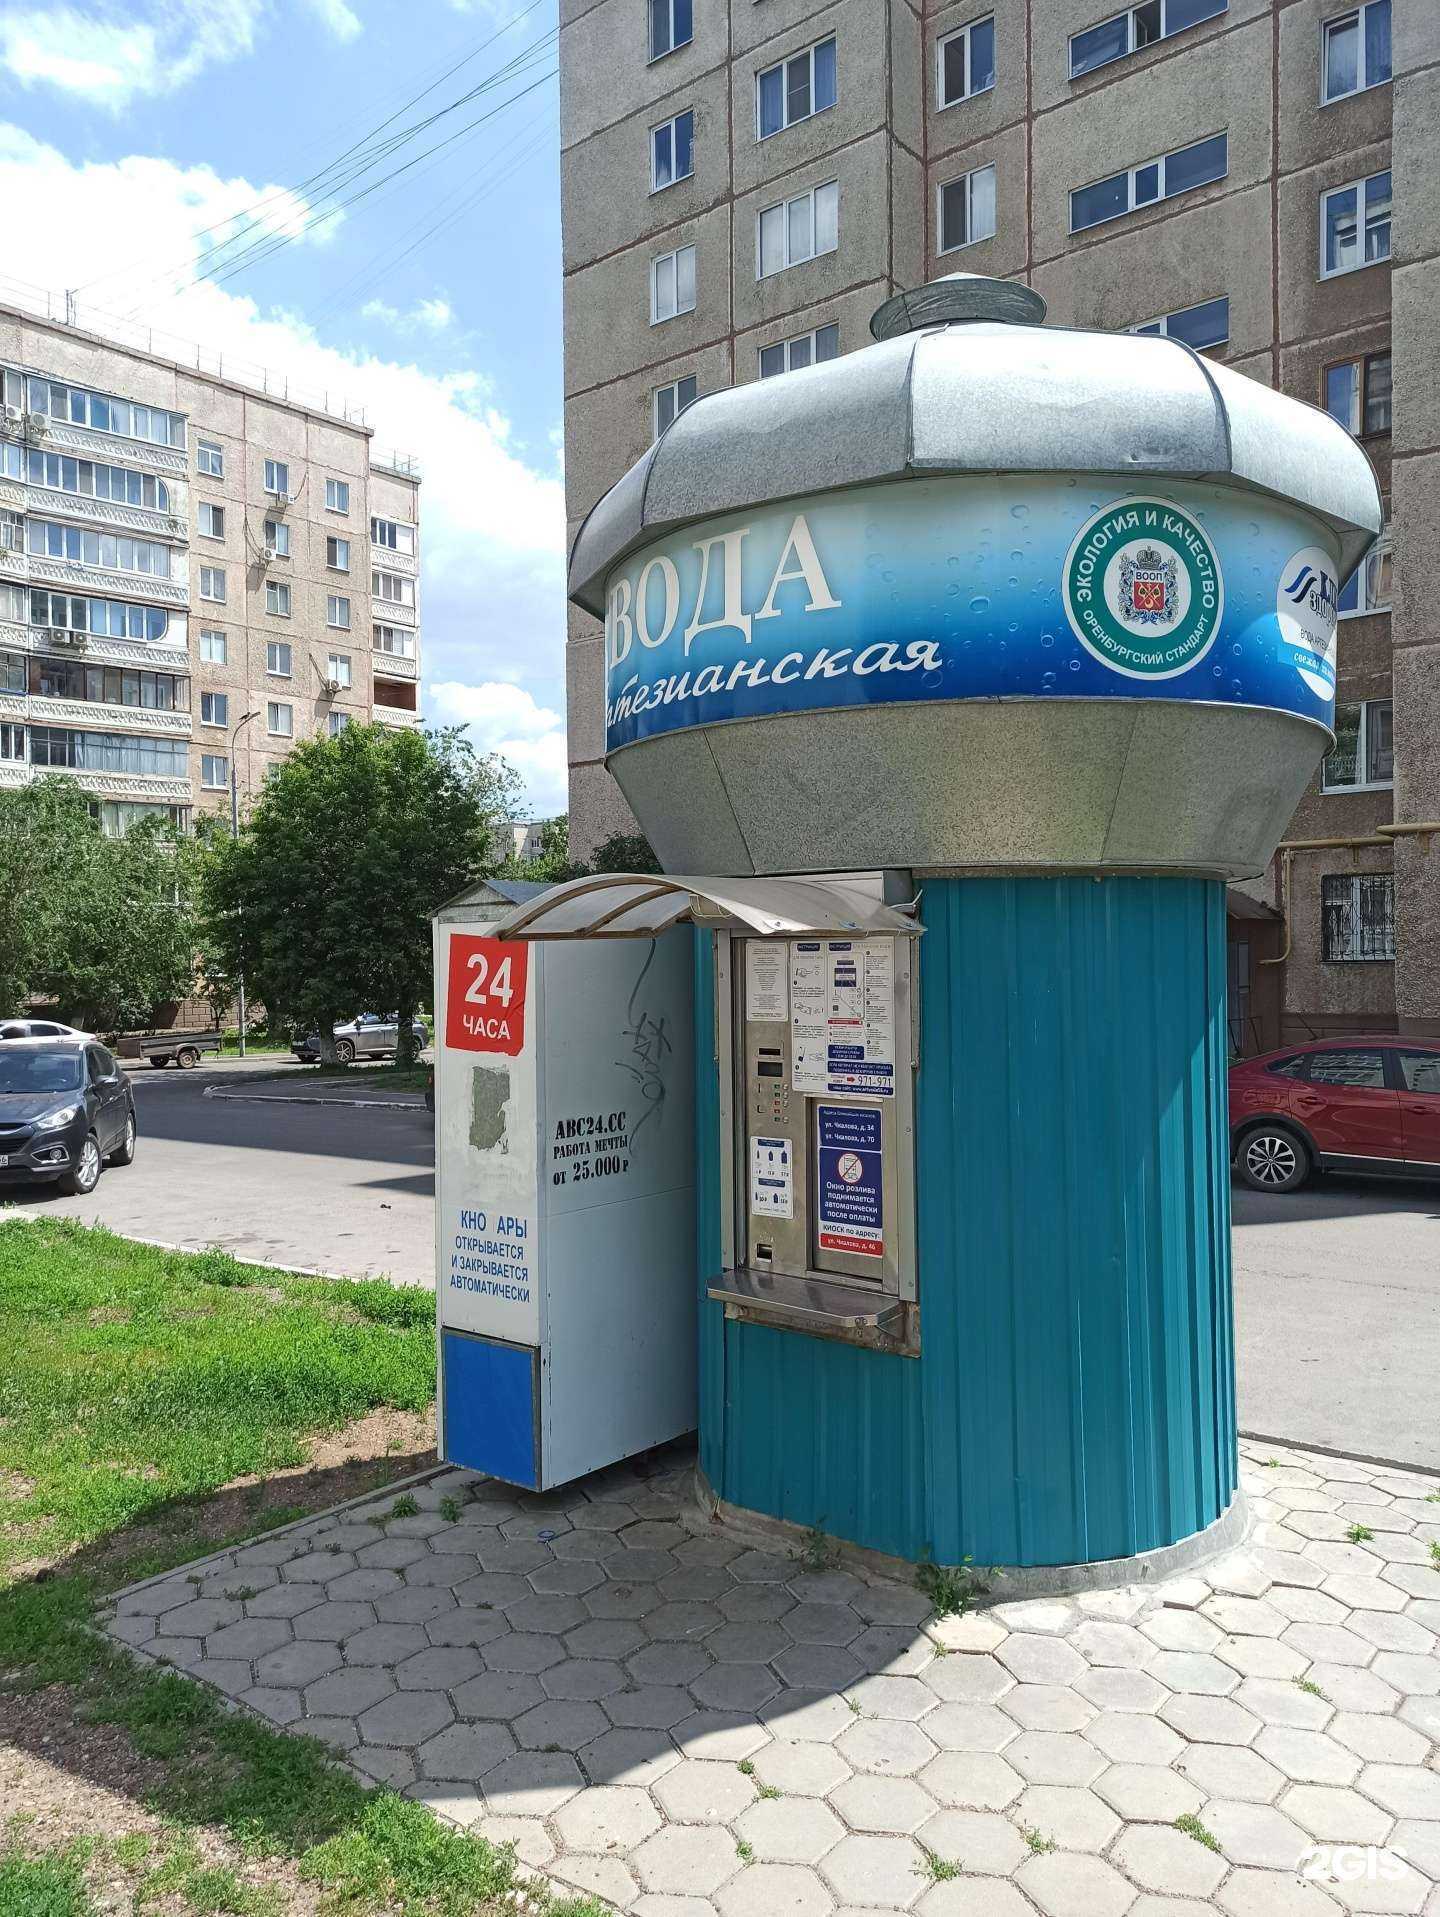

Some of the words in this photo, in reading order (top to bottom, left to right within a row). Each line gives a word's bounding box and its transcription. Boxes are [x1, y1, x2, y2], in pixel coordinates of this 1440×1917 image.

[1076, 511, 1140, 603] ЭКОЛОГИЯ
[1145, 510, 1157, 526] И
[1162, 514, 1215, 609] КАЧЕСТВО
[1135, 571, 1163, 581] ВООП
[607, 514, 842, 670] ВОДА
[1083, 609, 1164, 665] ОРЕНБУРГСКИЙ
[1165, 613, 1209, 662] СТАНДАРТ
[464, 953, 514, 1008] 24
[462, 1013, 511, 1040] ЧАСА
[857, 1075, 891, 1087] 971-971
[553, 1141, 591, 1159] РАБОТА
[594, 1135, 629, 1153] МЕЧТЫ
[573, 1155, 621, 1181] 25.000
[826, 1181, 845, 1191] Окно
[846, 1184, 876, 1195] розлива
[827, 1192, 875, 1203] поднимается
[824, 1201, 878, 1214] автоматически
[827, 1210, 848, 1219] после
[848, 1213, 876, 1223] оплаты
[455, 1235, 524, 1261] ОТКРЫВАЕТСЯ
[451, 1254, 458, 1268] И
[460, 1256, 529, 1282] ЗАКРЫВАЕТСЯ
[450, 1274, 530, 1303] АВТОМАТИЧЕСКИ
